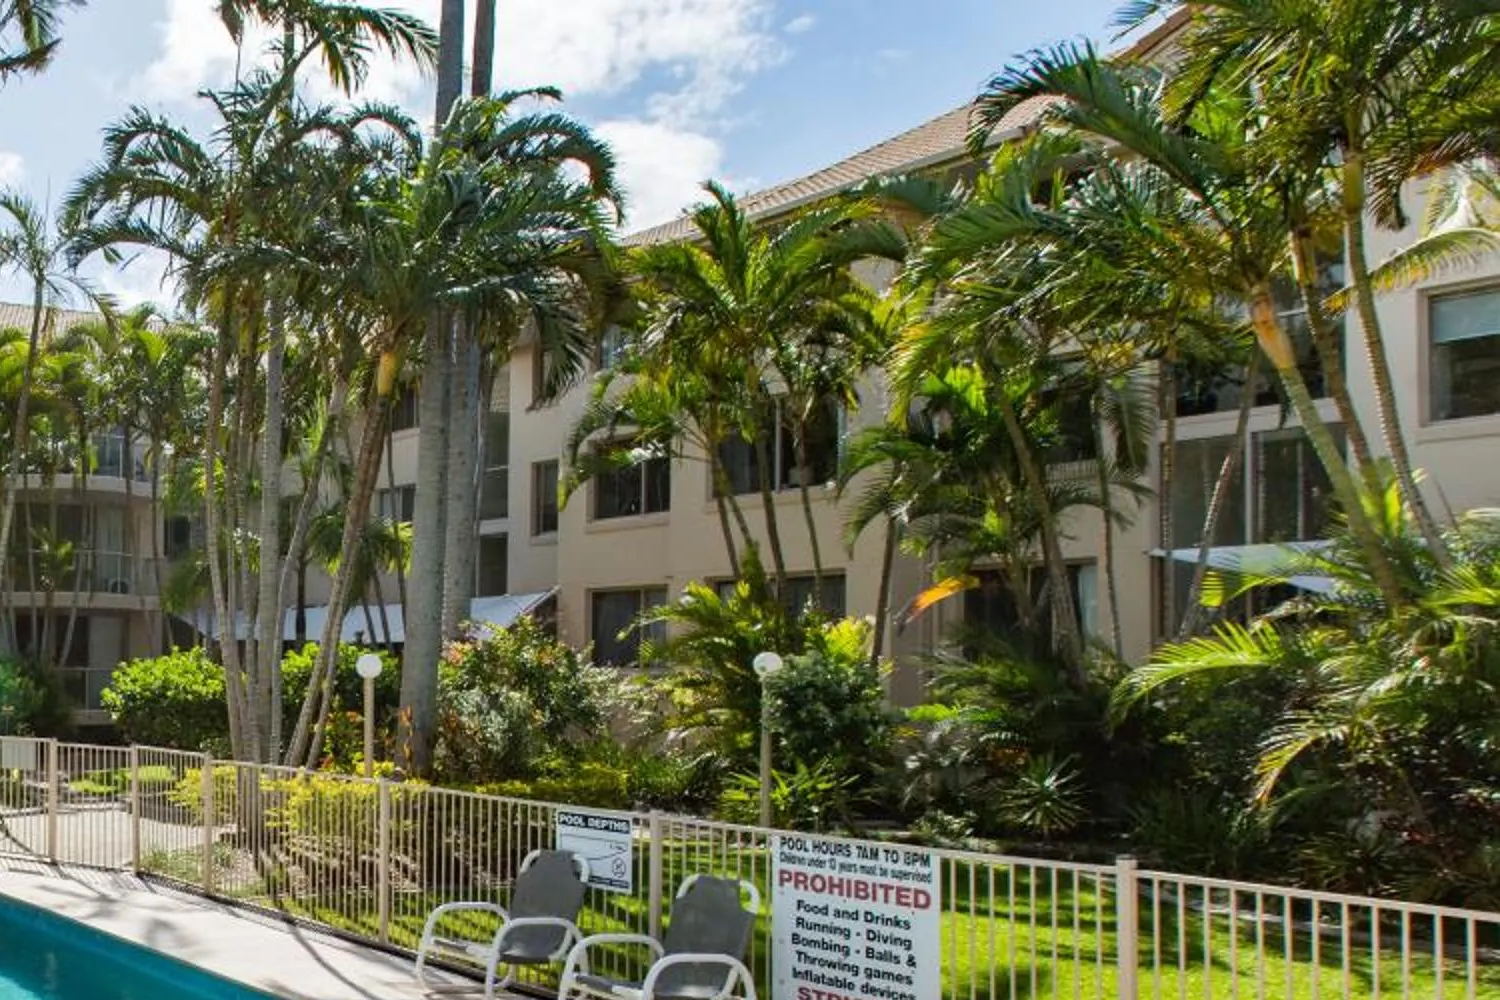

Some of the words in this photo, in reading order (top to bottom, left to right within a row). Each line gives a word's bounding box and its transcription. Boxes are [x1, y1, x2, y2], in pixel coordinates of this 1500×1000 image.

[559, 814, 586, 826] POOL
[587, 817, 629, 832] DEPTHS
[779, 836, 808, 852] POOL
[811, 840, 851, 858] HOURS
[855, 845, 878, 861] 7AM
[883, 849, 898, 863] TO
[778, 868, 931, 911] PROHIBITED
[796, 899, 828, 916] Food
[833, 906, 858, 921] and
[863, 910, 911, 930] Drinks
[795, 916, 850, 940] Running
[866, 928, 912, 950] Diving
[791, 932, 850, 957] Bombing
[865, 946, 900, 965] Balls
[906, 954, 916, 968] &
[792, 966, 854, 991] Inflatable
[795, 950, 858, 977] Throwing
[863, 966, 912, 988] games
